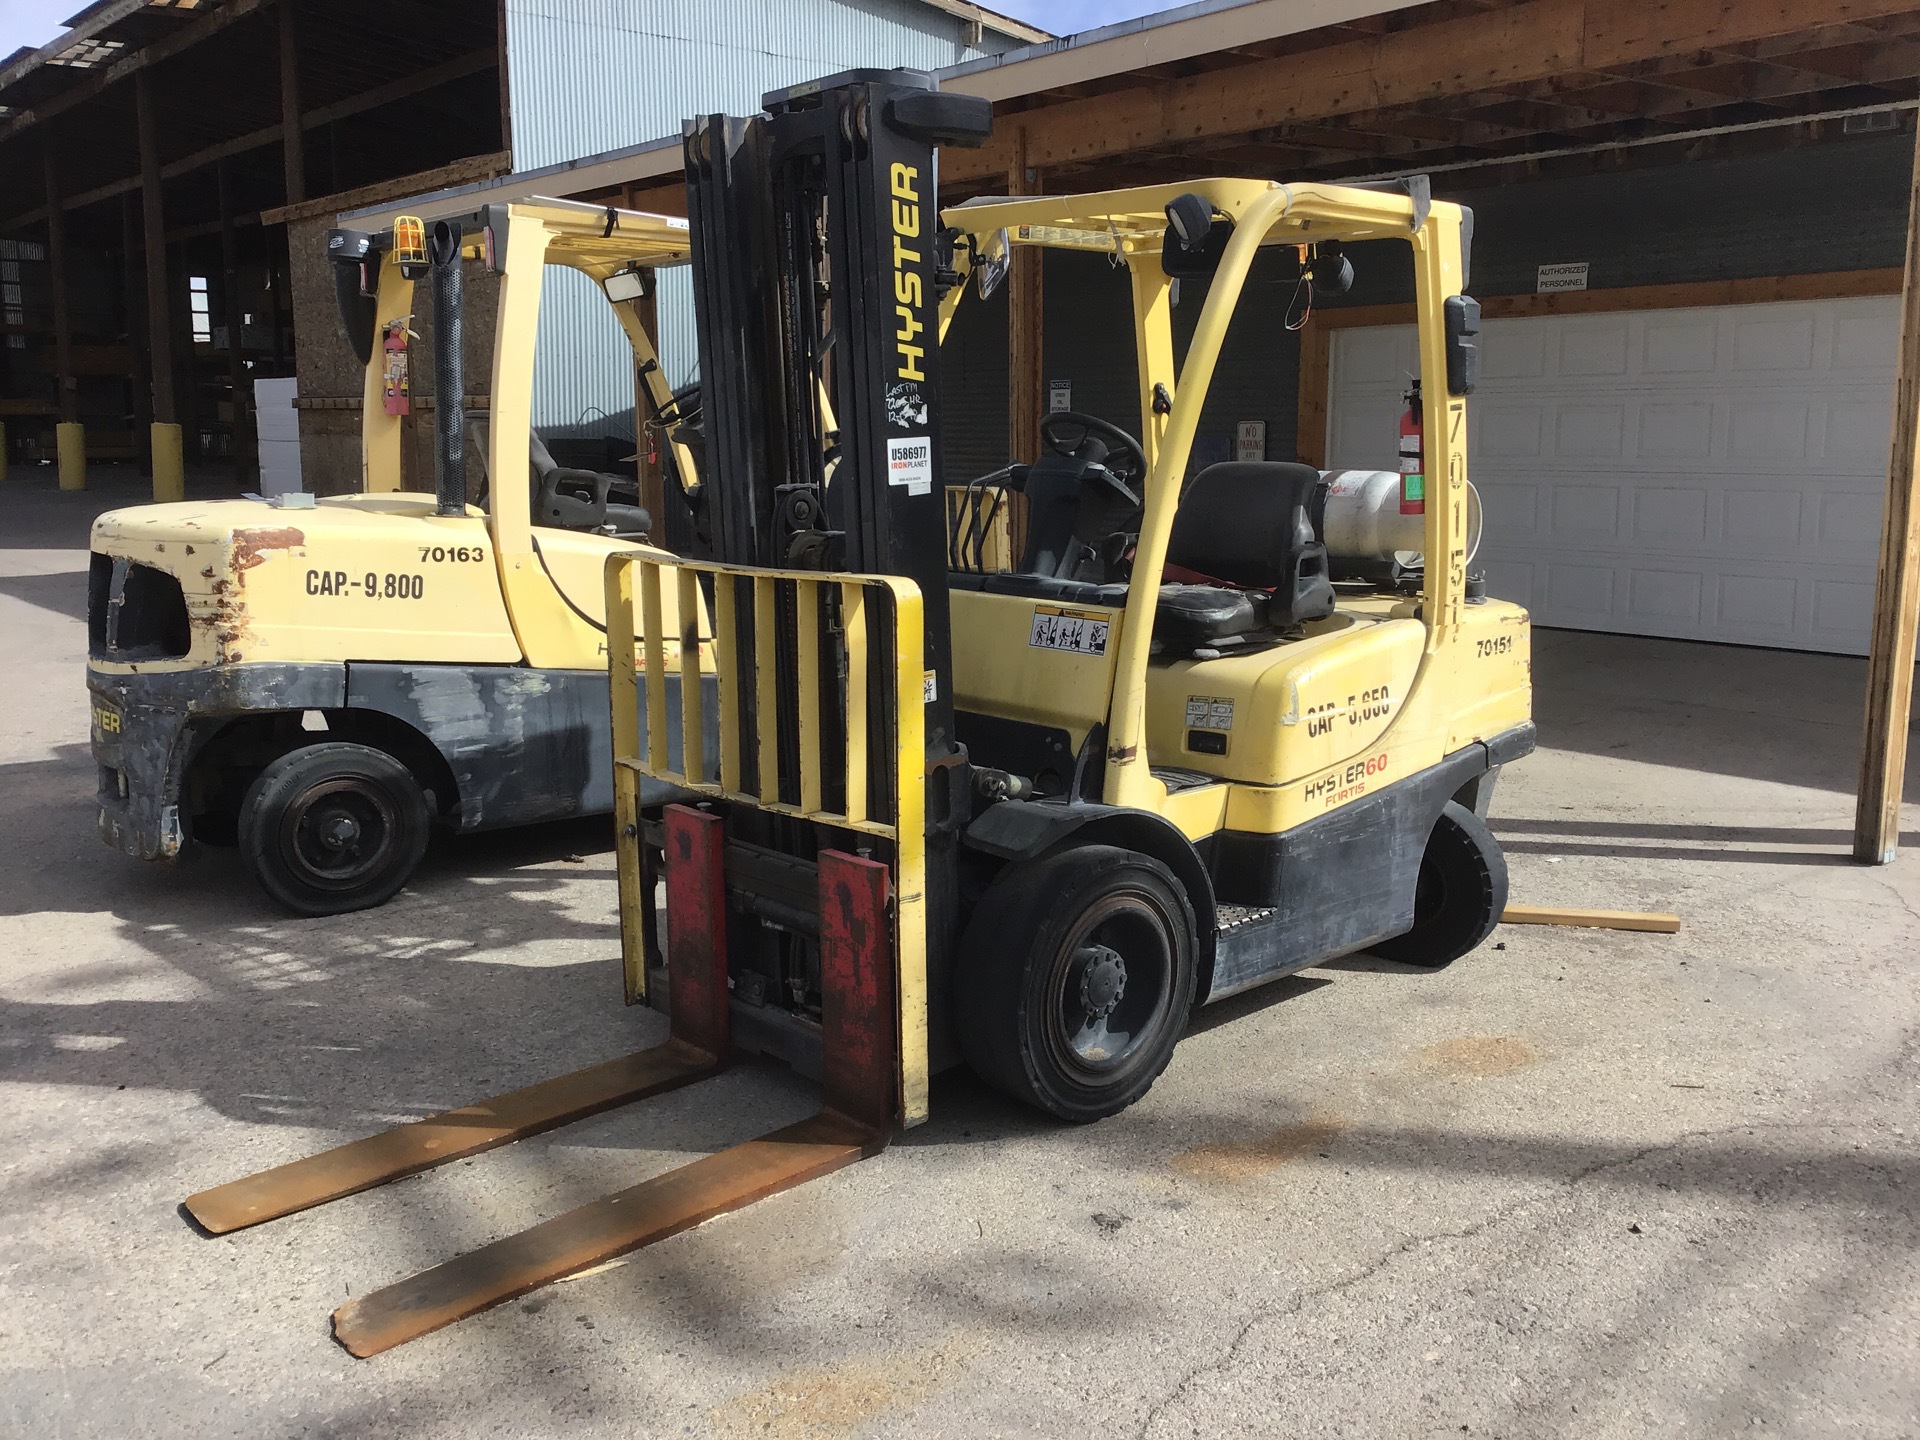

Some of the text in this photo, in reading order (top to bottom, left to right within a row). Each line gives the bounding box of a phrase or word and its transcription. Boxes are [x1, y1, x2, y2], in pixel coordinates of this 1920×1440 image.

[890, 162, 925, 382] HYSTER
[1540, 265, 1587, 276] AUTHORIZED
[1540, 278, 1585, 288] PERSONNEL
[1245, 426, 1257, 438] NO
[1239, 439, 1263, 451] PARKING
[891, 446, 927, 461] U586977
[418, 546, 484, 563] 70163
[1476, 635, 1513, 658] 70151
[1325, 782, 1365, 808] FORTIS
